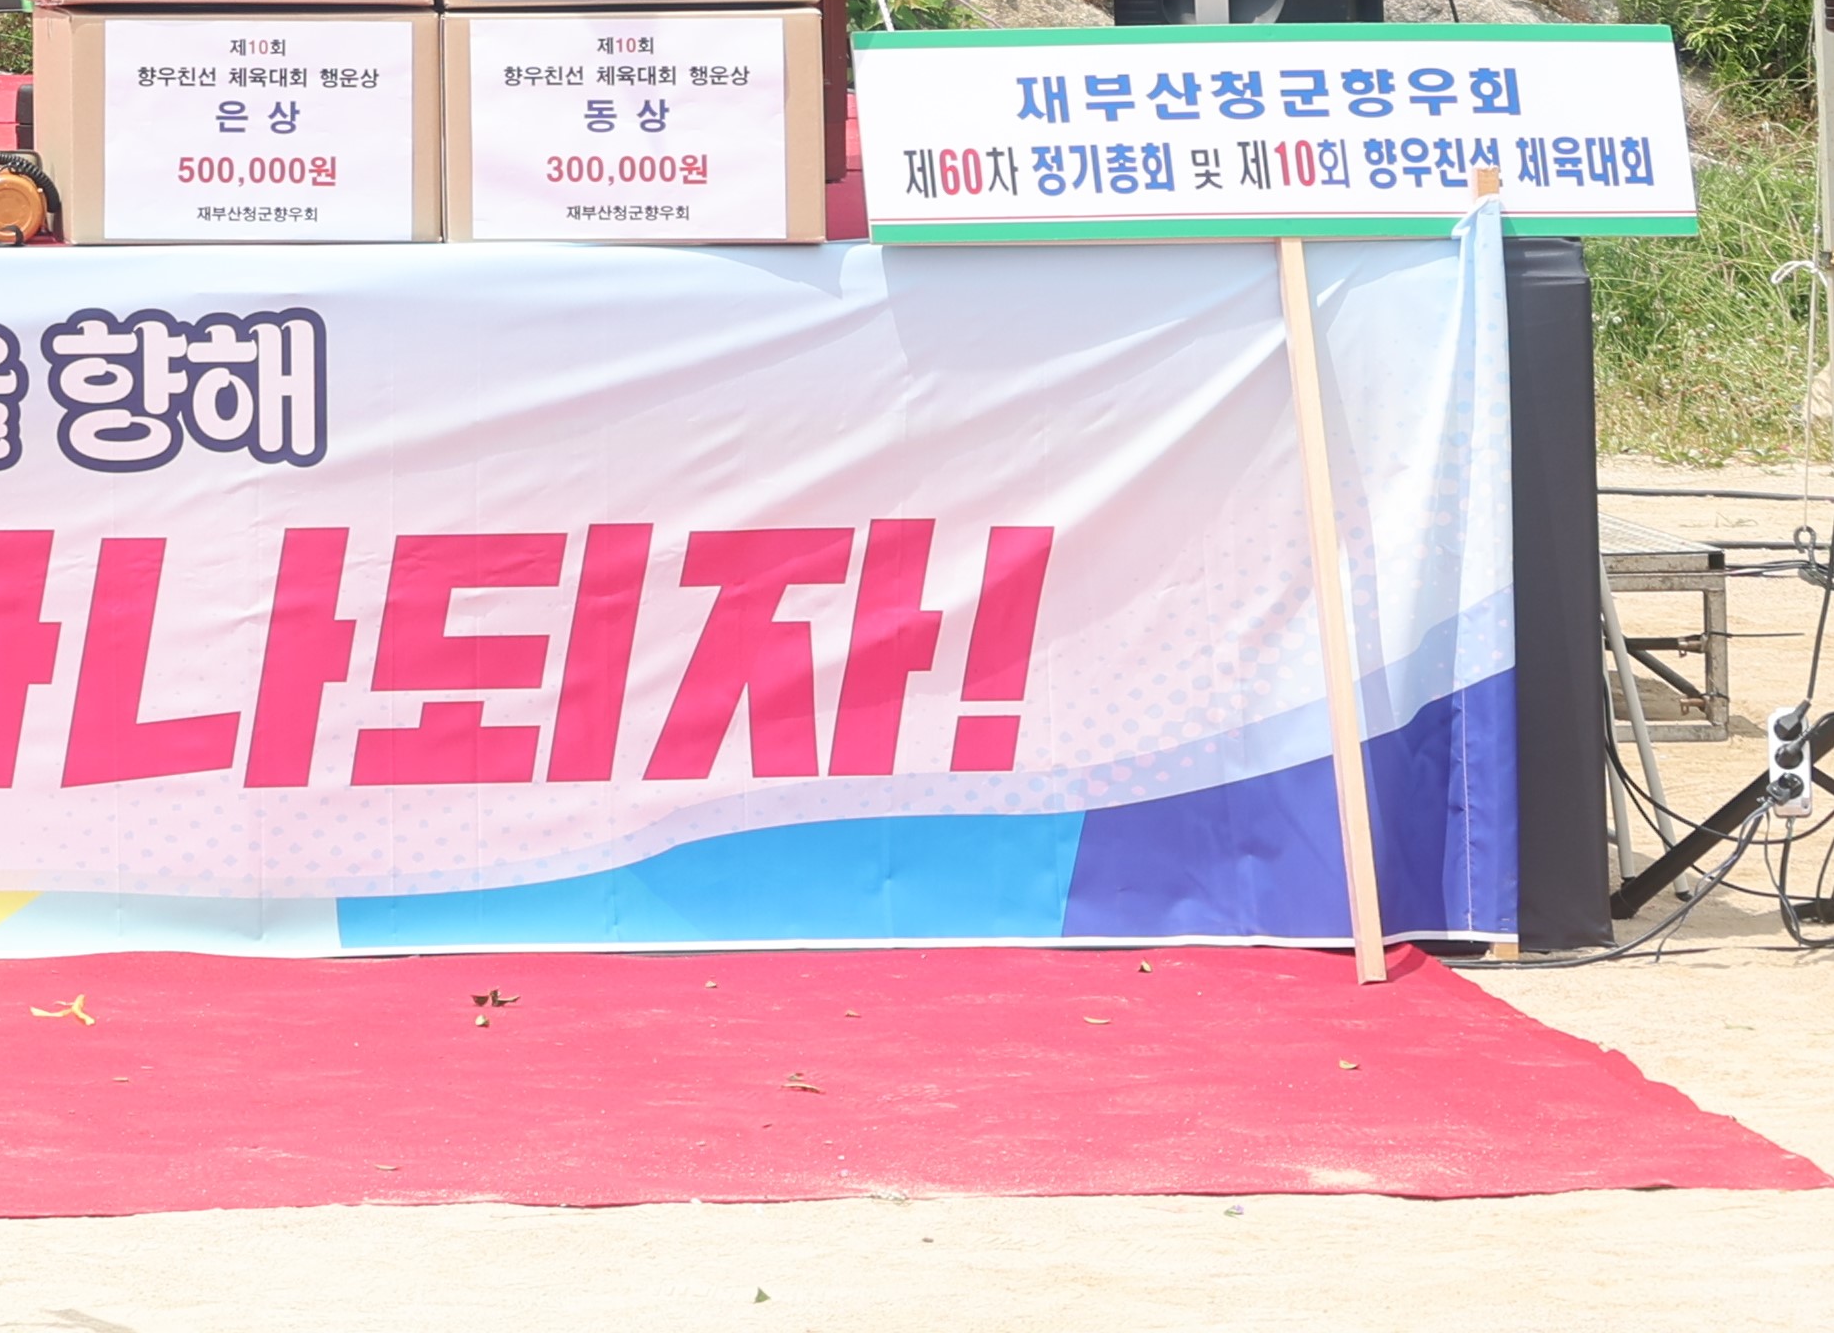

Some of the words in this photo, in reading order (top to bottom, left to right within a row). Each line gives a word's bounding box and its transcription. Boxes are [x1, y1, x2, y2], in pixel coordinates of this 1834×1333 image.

[230, 39, 285, 56] 제10회
[597, 37, 653, 54] 제10회
[138, 67, 216, 87] 향우친선
[229, 68, 307, 87] 체육대회
[320, 68, 379, 88] 행운상
[504, 66, 583, 86] 향우친선
[596, 66, 676, 86] 체육대회
[689, 66, 750, 86] 행운상
[1016, 68, 1521, 123] 재부산청군향우회
[216, 101, 248, 133] 은
[268, 101, 300, 134] 상
[584, 100, 617, 133] 동
[637, 99, 669, 133] 상
[178, 156, 336, 186] 500,000원
[547, 154, 707, 186] 300,000원
[903, 147, 1018, 198] 제60차
[1031, 143, 1175, 196] 정기총회
[1191, 148, 1223, 189] 및
[1237, 139, 1350, 189] 제10회
[1516, 137, 1654, 187] 체육대회
[197, 207, 317, 222] 재부산청군향우회
[567, 205, 689, 221] 재부산청군향우회
[54, 313, 322, 463] 향해
